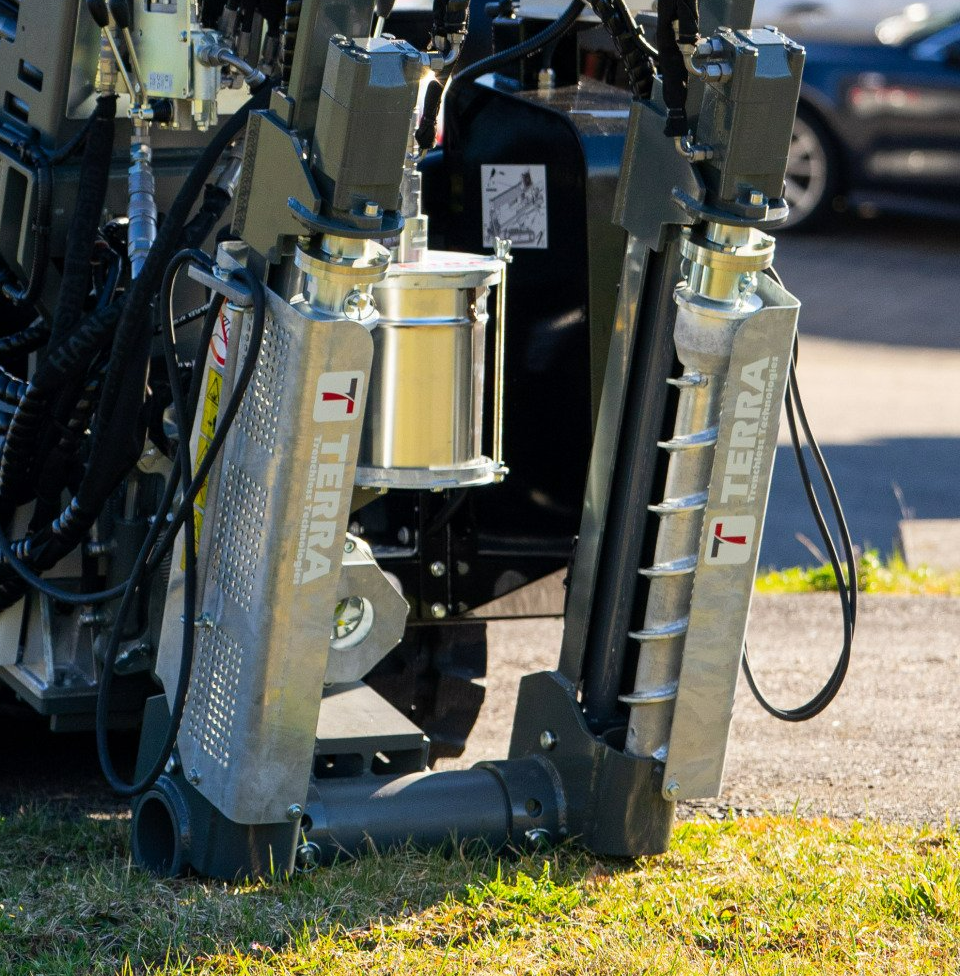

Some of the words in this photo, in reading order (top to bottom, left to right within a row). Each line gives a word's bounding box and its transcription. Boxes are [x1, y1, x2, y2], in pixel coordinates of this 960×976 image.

[720, 356, 770, 504] TERRA
[746, 438, 766, 504] Trenchless
[758, 355, 780, 436] Technologies
[300, 433, 351, 586] TERRA
